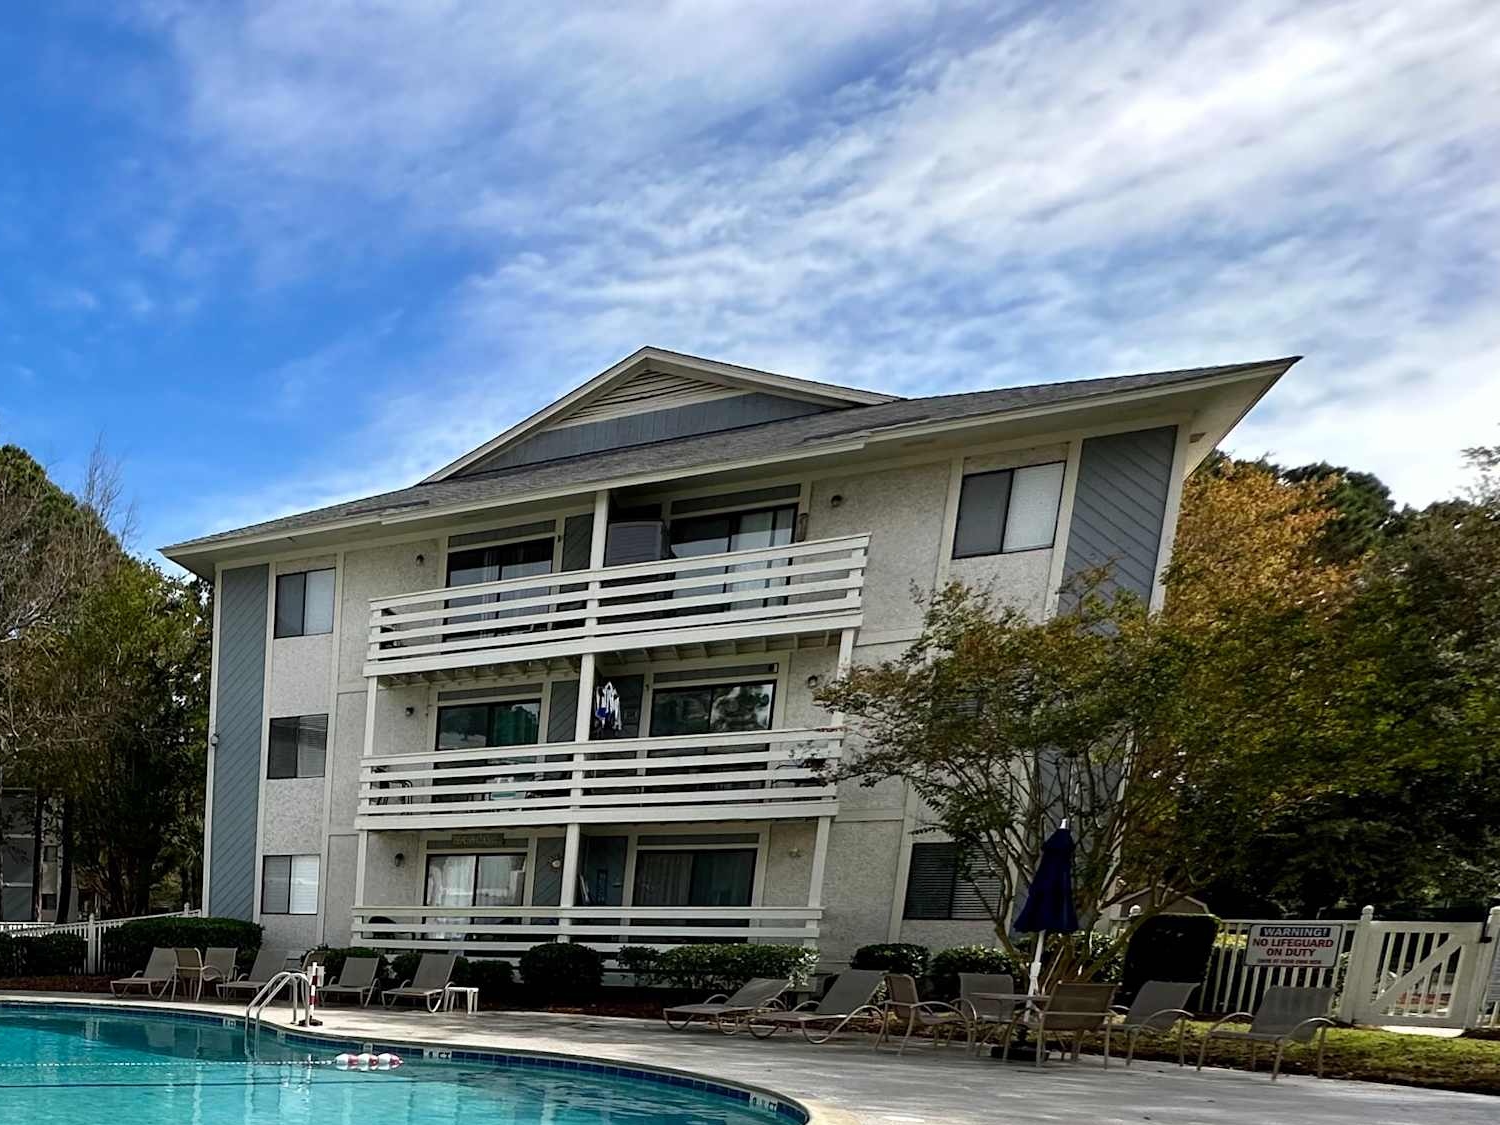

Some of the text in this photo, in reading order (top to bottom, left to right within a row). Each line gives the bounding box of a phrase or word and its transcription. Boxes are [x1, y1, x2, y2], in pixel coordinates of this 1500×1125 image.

[1263, 927, 1328, 937] WARNING!
[1252, 938, 1334, 948] NO LIFEGUARD
[1266, 948, 1316, 957] ON DUTY
